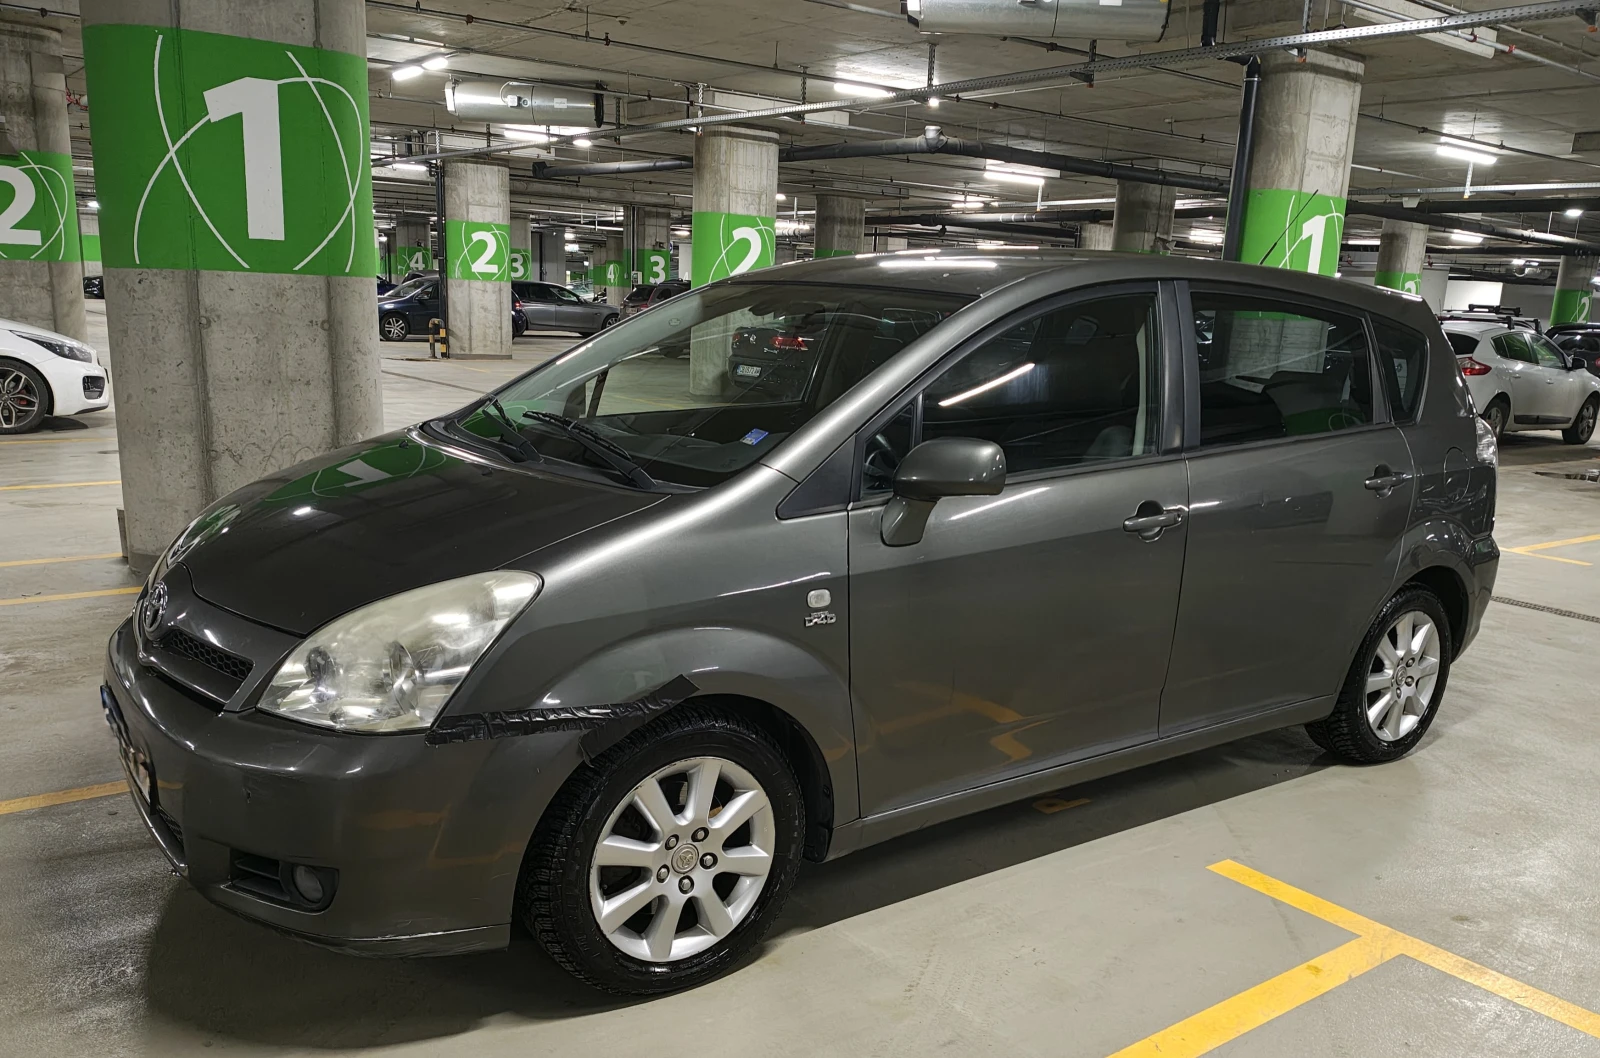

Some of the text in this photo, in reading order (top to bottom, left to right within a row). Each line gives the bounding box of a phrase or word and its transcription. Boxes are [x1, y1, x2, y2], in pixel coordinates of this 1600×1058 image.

[203, 77, 284, 241] 1
[0, 166, 42, 245] 2
[410, 252, 425, 271] 4
[472, 231, 498, 273] 2
[732, 227, 761, 276] 2
[1303, 215, 1326, 274] 1
[511, 254, 524, 278] 3
[607, 264, 615, 283] 4
[650, 255, 666, 284] 3
[1577, 297, 1589, 323] 2
